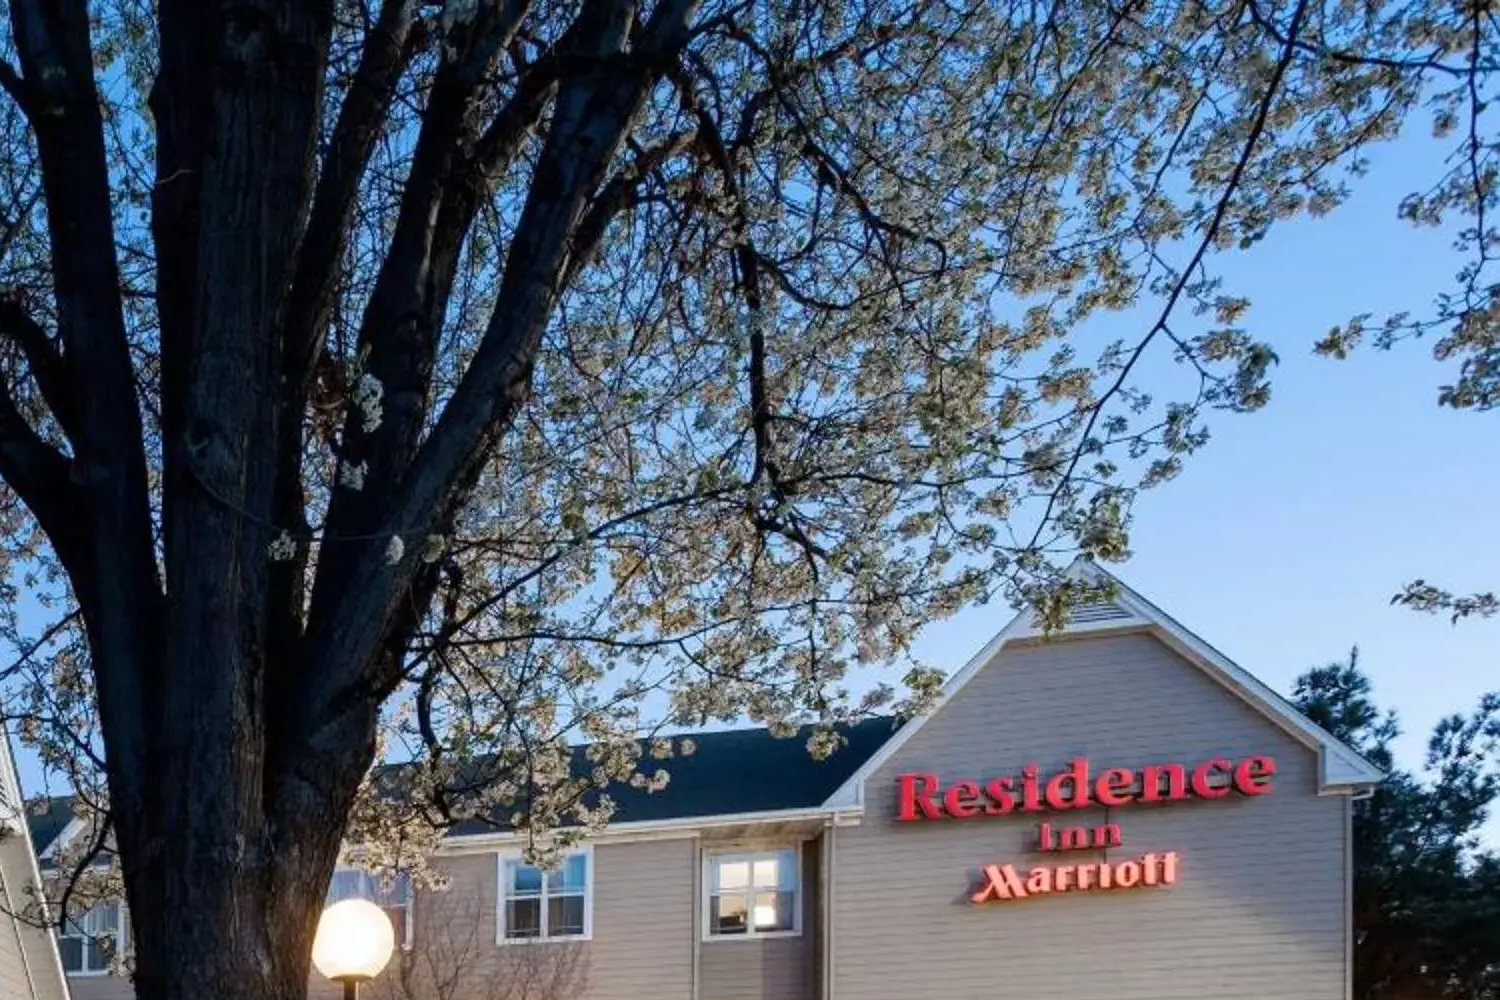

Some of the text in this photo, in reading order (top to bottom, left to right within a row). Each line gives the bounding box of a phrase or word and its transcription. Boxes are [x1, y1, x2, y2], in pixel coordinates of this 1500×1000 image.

[895, 755, 1277, 821] Residence
[1039, 822, 1122, 850] Inn
[972, 851, 1179, 903] Marriott
